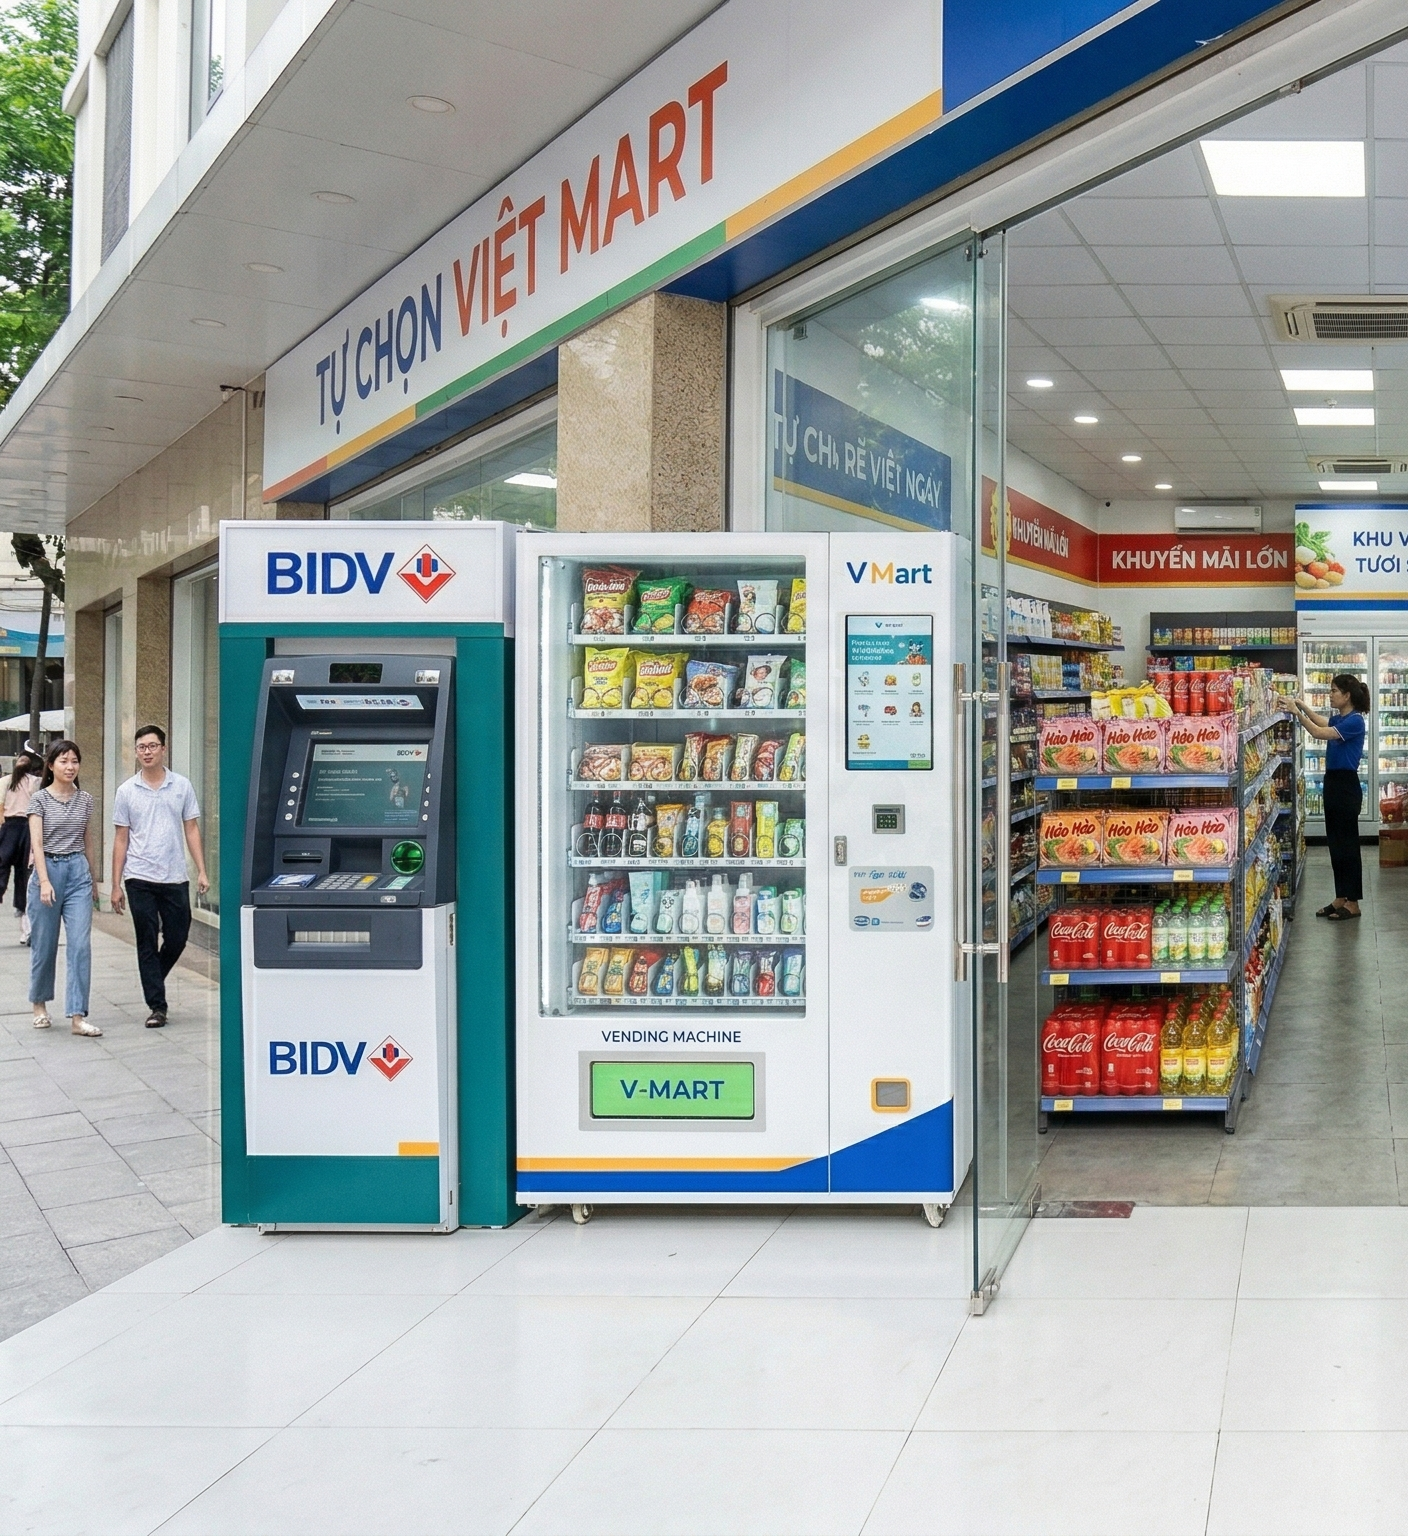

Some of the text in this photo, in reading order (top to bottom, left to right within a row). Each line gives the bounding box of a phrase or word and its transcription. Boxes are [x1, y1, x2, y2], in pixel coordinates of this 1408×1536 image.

[316, 60, 728, 435] TỰ CHỌN VIỆT MART
[1353, 531, 1393, 548] KHU
[267, 552, 395, 594] BIDV
[1355, 554, 1401, 573] TƯƠI
[601, 1030, 742, 1044] VENDING MACHINE
[269, 1041, 367, 1076] BIDV
[619, 1079, 725, 1101] V-MART
